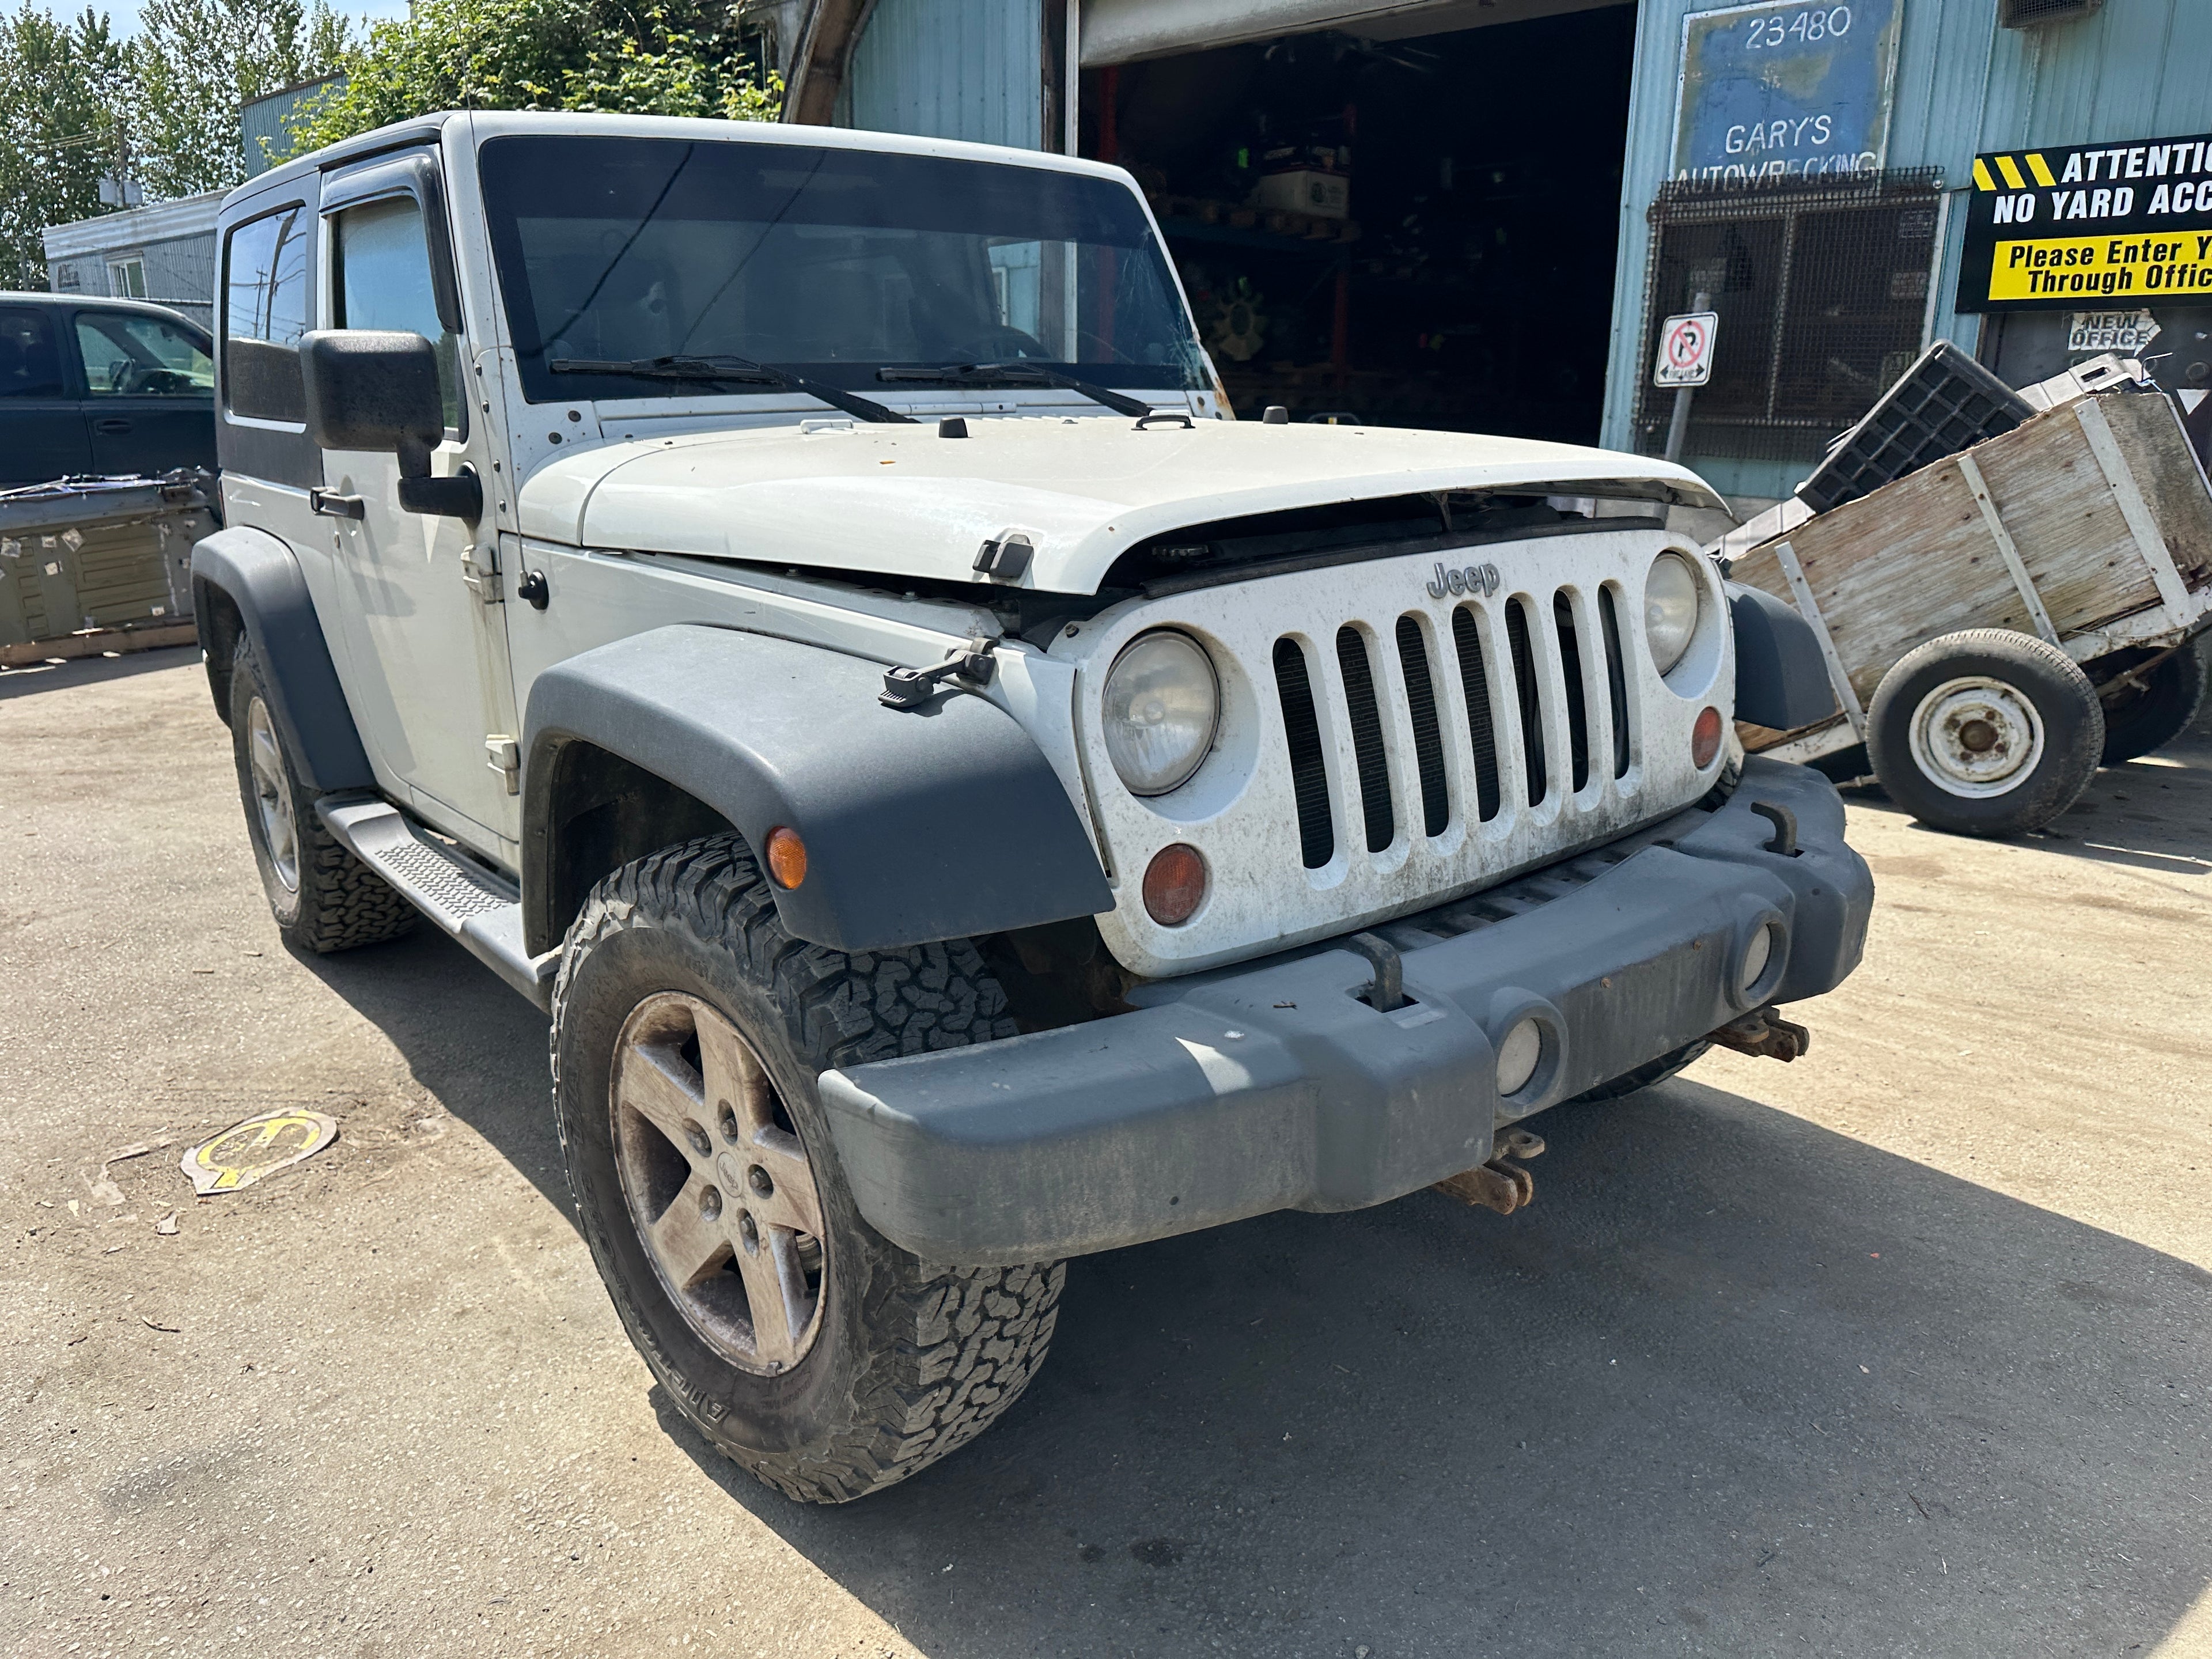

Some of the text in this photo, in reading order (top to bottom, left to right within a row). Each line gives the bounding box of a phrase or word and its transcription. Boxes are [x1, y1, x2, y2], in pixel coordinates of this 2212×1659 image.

[1746, 6, 1851, 50] 23480
[1725, 115, 1832, 154] GARY'S
[1993, 180, 2212, 225] NO YARD ACC
[2009, 236, 2212, 269] Please Enter Y
[2028, 263, 2212, 294] Through Offic
[2072, 328, 2148, 347] OFFICE
[2084, 315, 2139, 331] NEW
[1426, 562, 1501, 599] Jeep
[719, 1161, 739, 1191] Jeep
